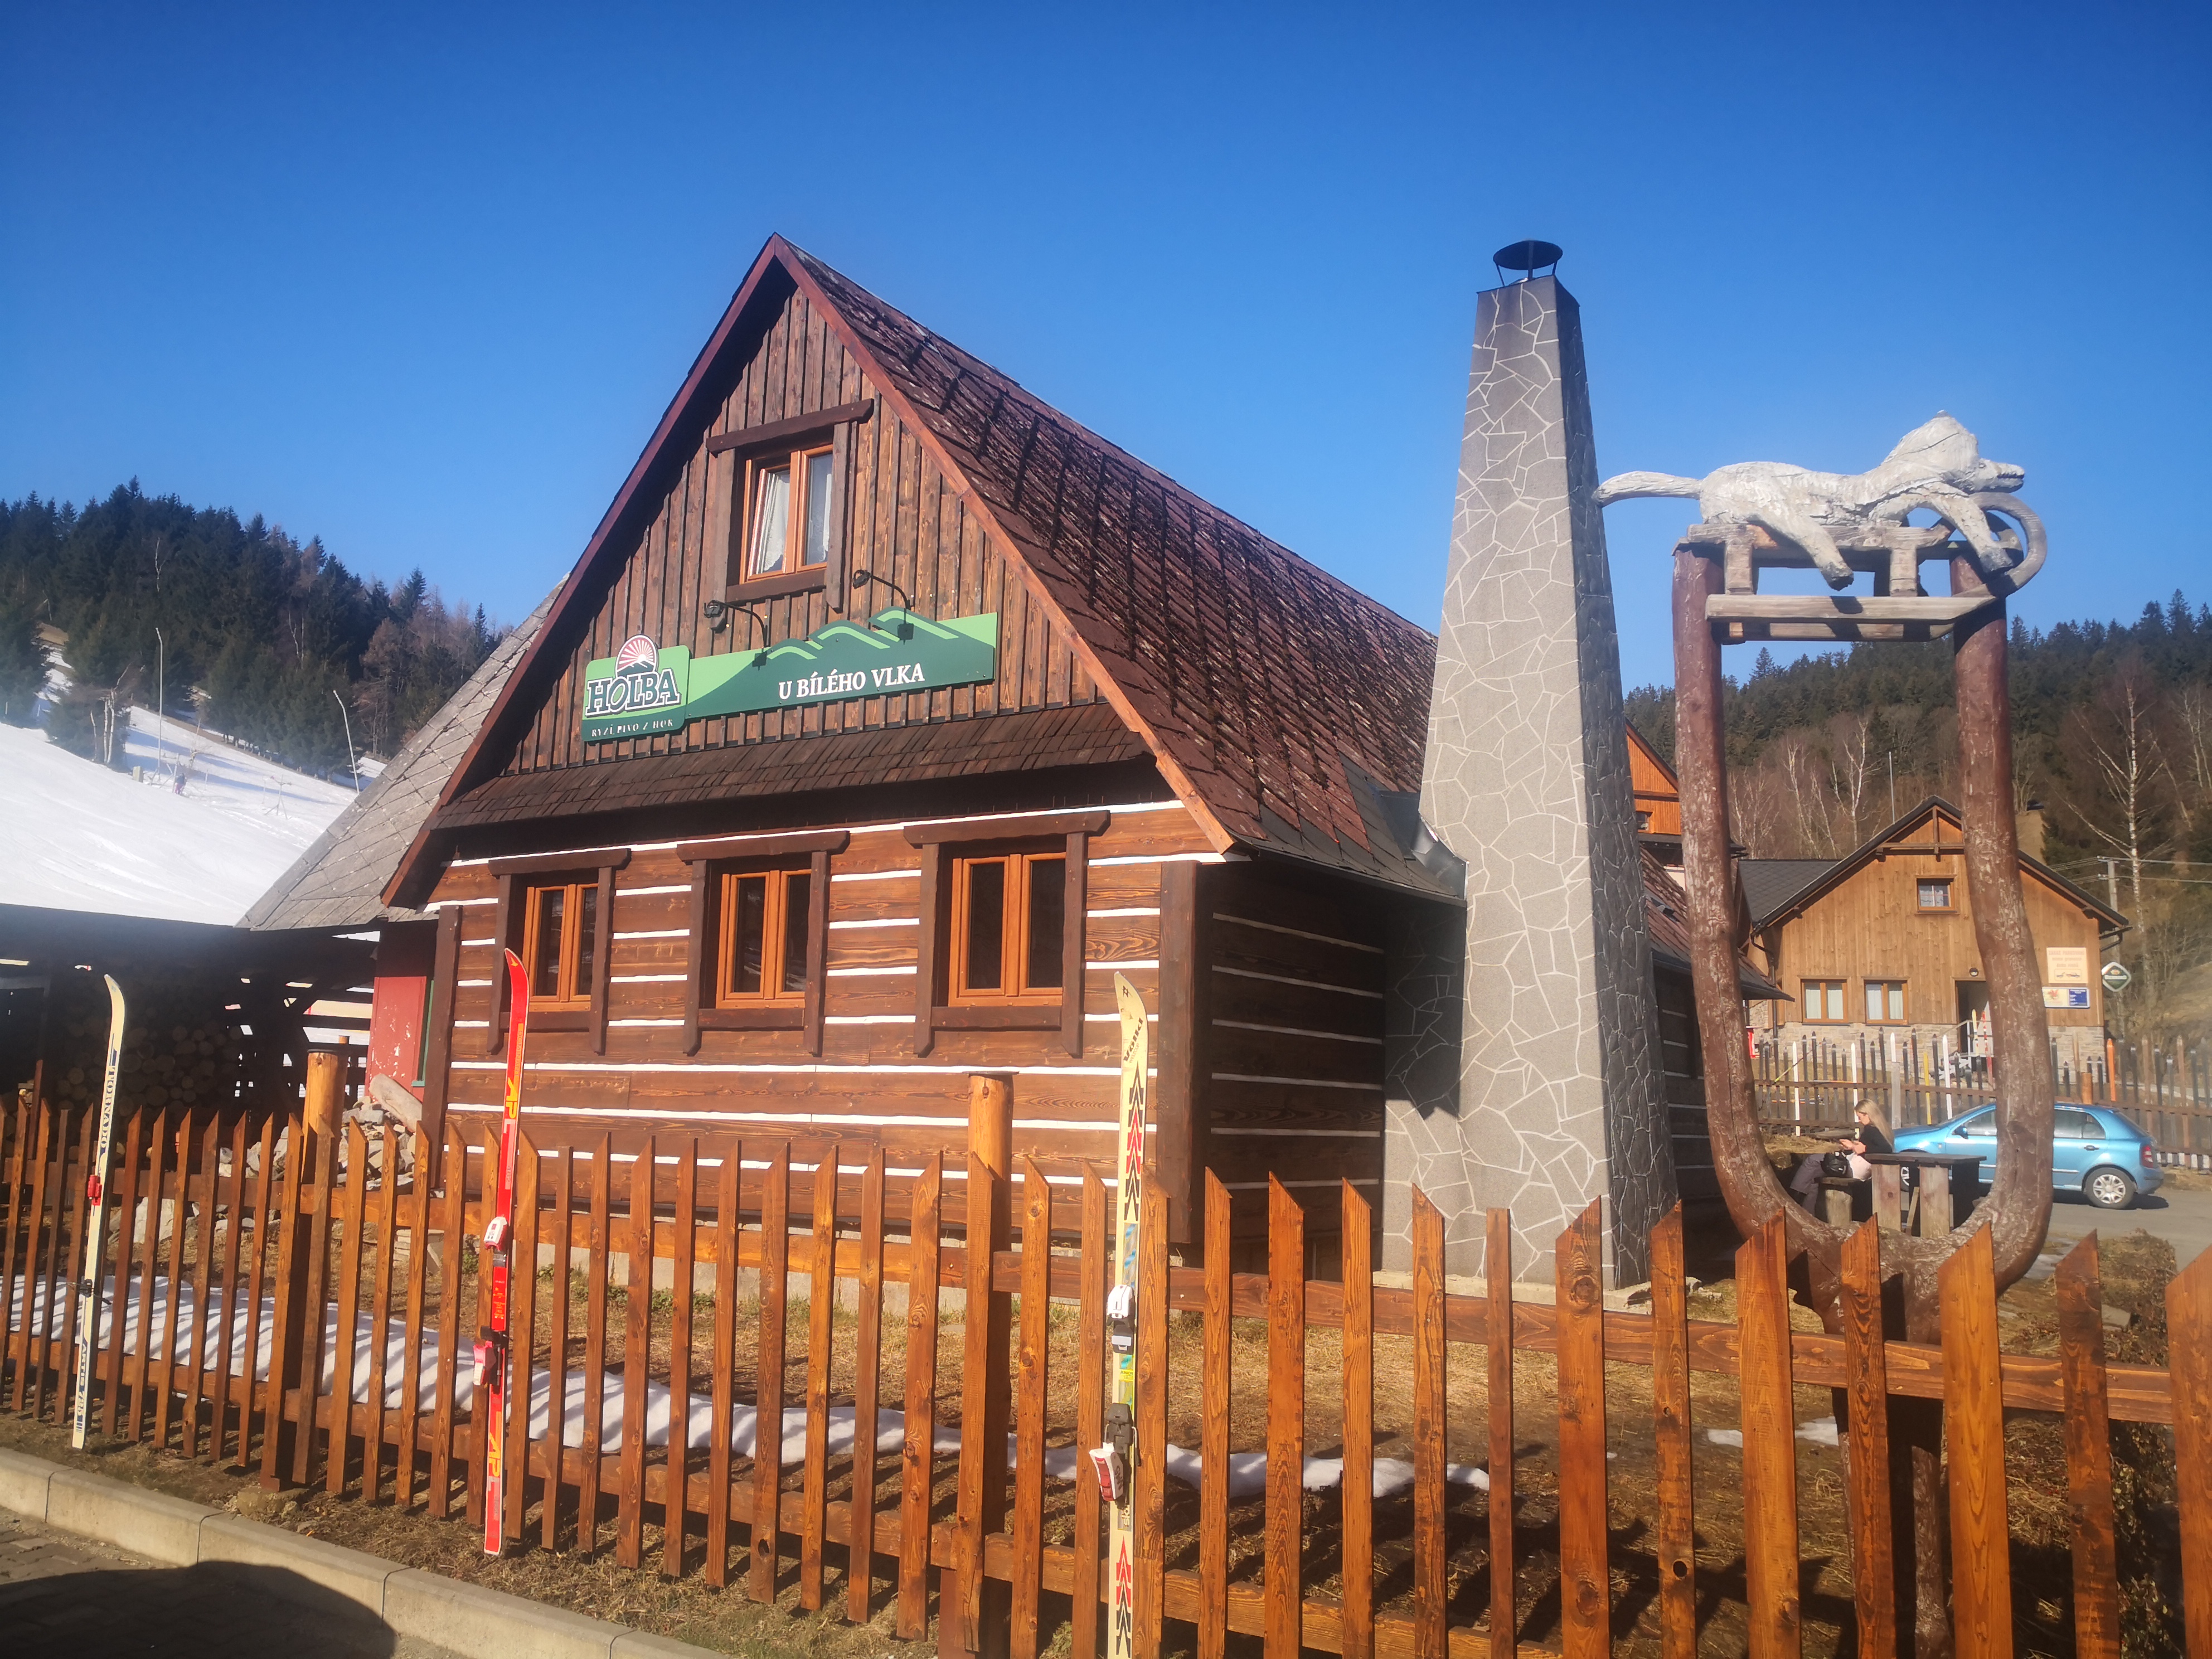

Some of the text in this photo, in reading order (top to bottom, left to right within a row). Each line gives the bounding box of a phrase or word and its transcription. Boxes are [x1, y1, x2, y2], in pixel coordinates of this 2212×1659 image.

[585, 668, 681, 717] HOLBA
[778, 662, 925, 700] U BÍLÉHO VLKA
[617, 722, 639, 734] PIVO
[100, 1065, 115, 1148] TORNADO
